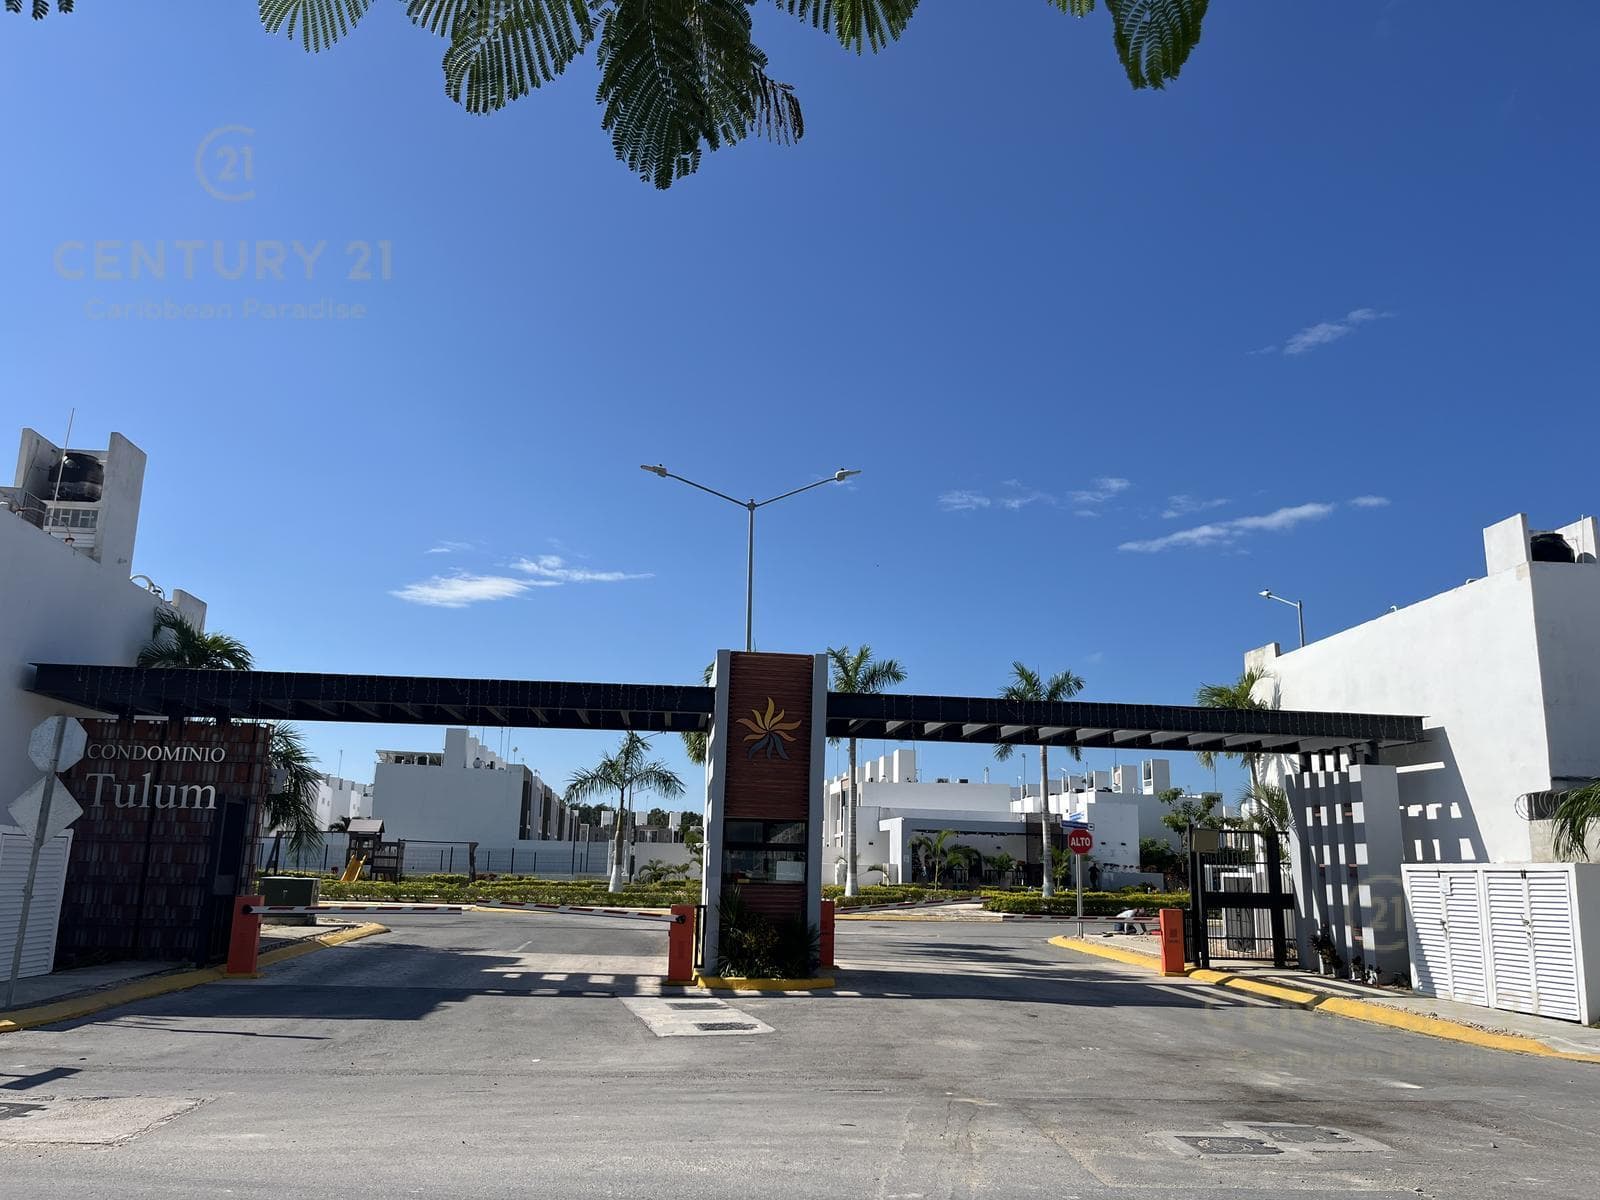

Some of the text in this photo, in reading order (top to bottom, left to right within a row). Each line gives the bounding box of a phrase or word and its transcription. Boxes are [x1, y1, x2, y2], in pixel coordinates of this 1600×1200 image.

[87, 743, 226, 763] CONDOMINIO
[85, 772, 217, 809] Tulum
[1070, 837, 1091, 847] ALTO
